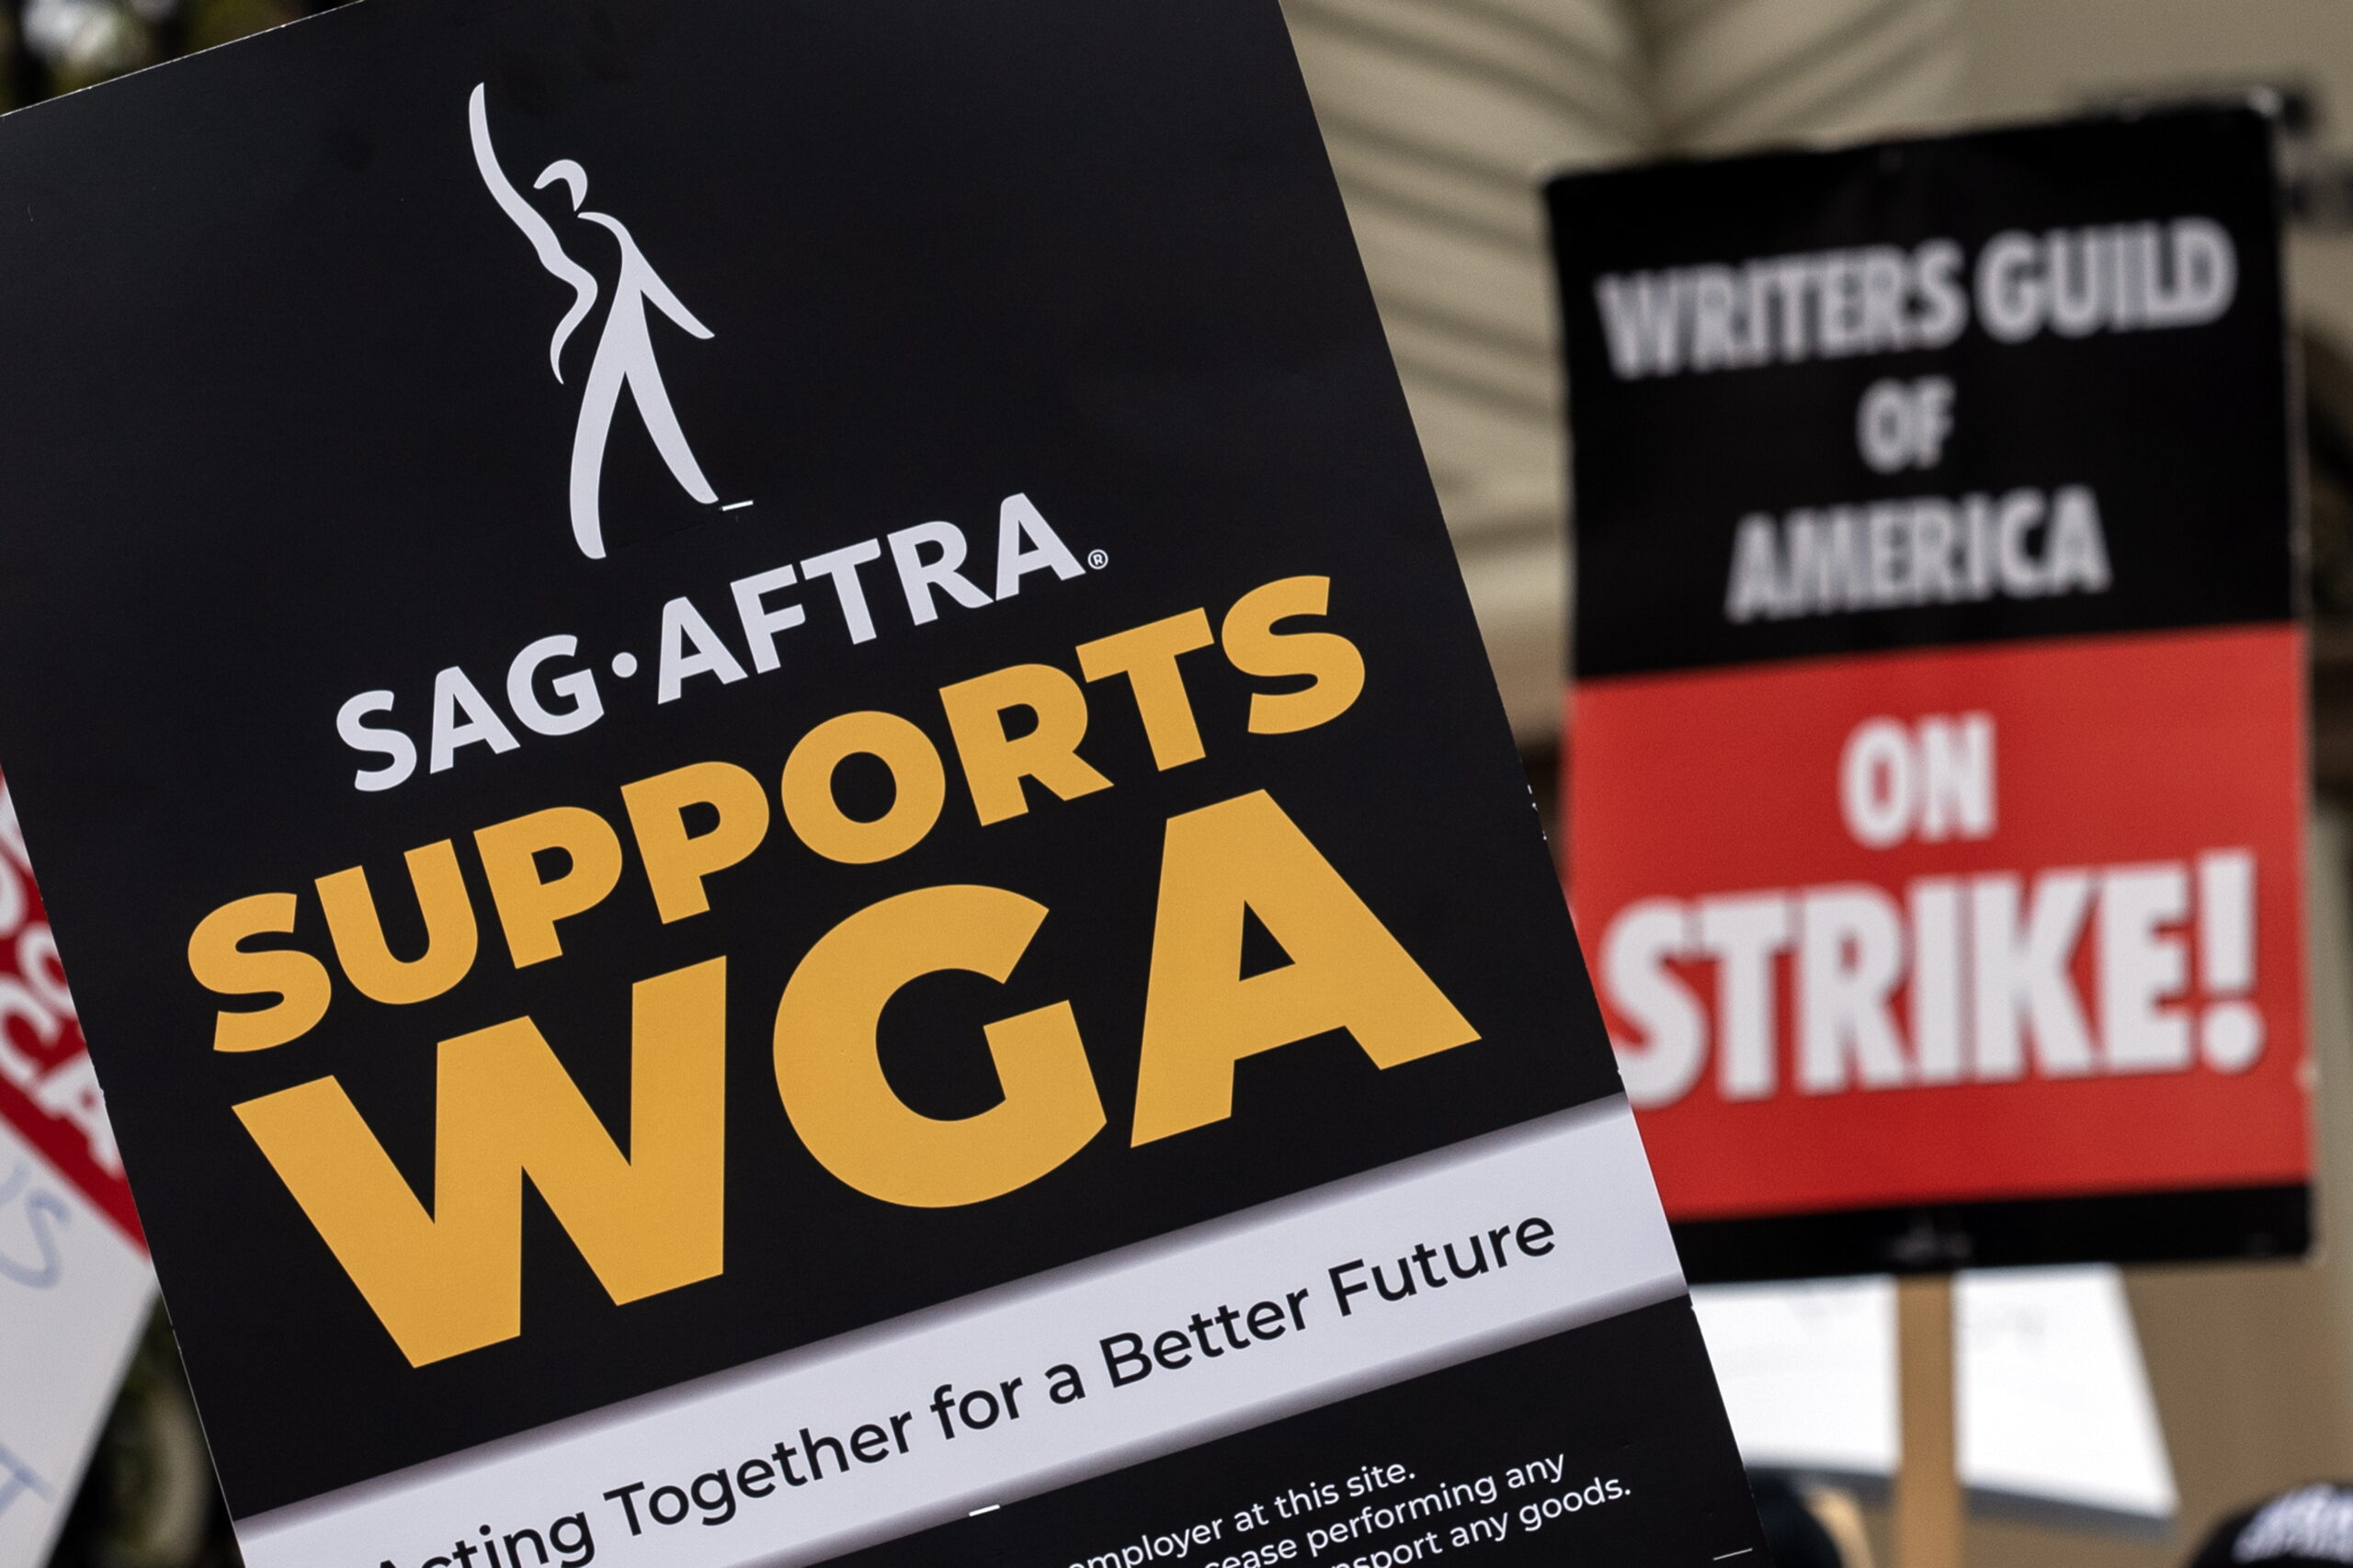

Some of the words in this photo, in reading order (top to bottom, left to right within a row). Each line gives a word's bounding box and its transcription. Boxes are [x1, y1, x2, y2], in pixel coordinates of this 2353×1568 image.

[1597, 241, 1967, 377] WRITERS
[1975, 219, 2236, 341] GUILD
[1859, 377, 1954, 471] OF
[1726, 485, 2110, 621] AMERICA
[188, 575, 1366, 1053] SUPPORTS
[1842, 712, 1995, 849] ON
[1599, 847, 2266, 1109] STRIKE!
[232, 789, 1482, 1369] WGA
[379, 1512, 596, 1568] ting
[602, 1412, 912, 1536] Together
[930, 1378, 1022, 1439] for
[1044, 1364, 1086, 1403] a
[1099, 1289, 1309, 1388] Better
[1328, 1218, 1555, 1316] Future
[1068, 1519, 1222, 1568] mployer
[1234, 1504, 1269, 1531] at
[1274, 1482, 1339, 1518] this
[1347, 1463, 1415, 1497] site.
[1204, 1540, 1297, 1568] ease
[1307, 1476, 1497, 1557] performing
[1506, 1454, 1564, 1489] any
[1331, 1532, 1443, 1568] sport
[1449, 1513, 1508, 1548] any
[1519, 1477, 1631, 1531] goods.
